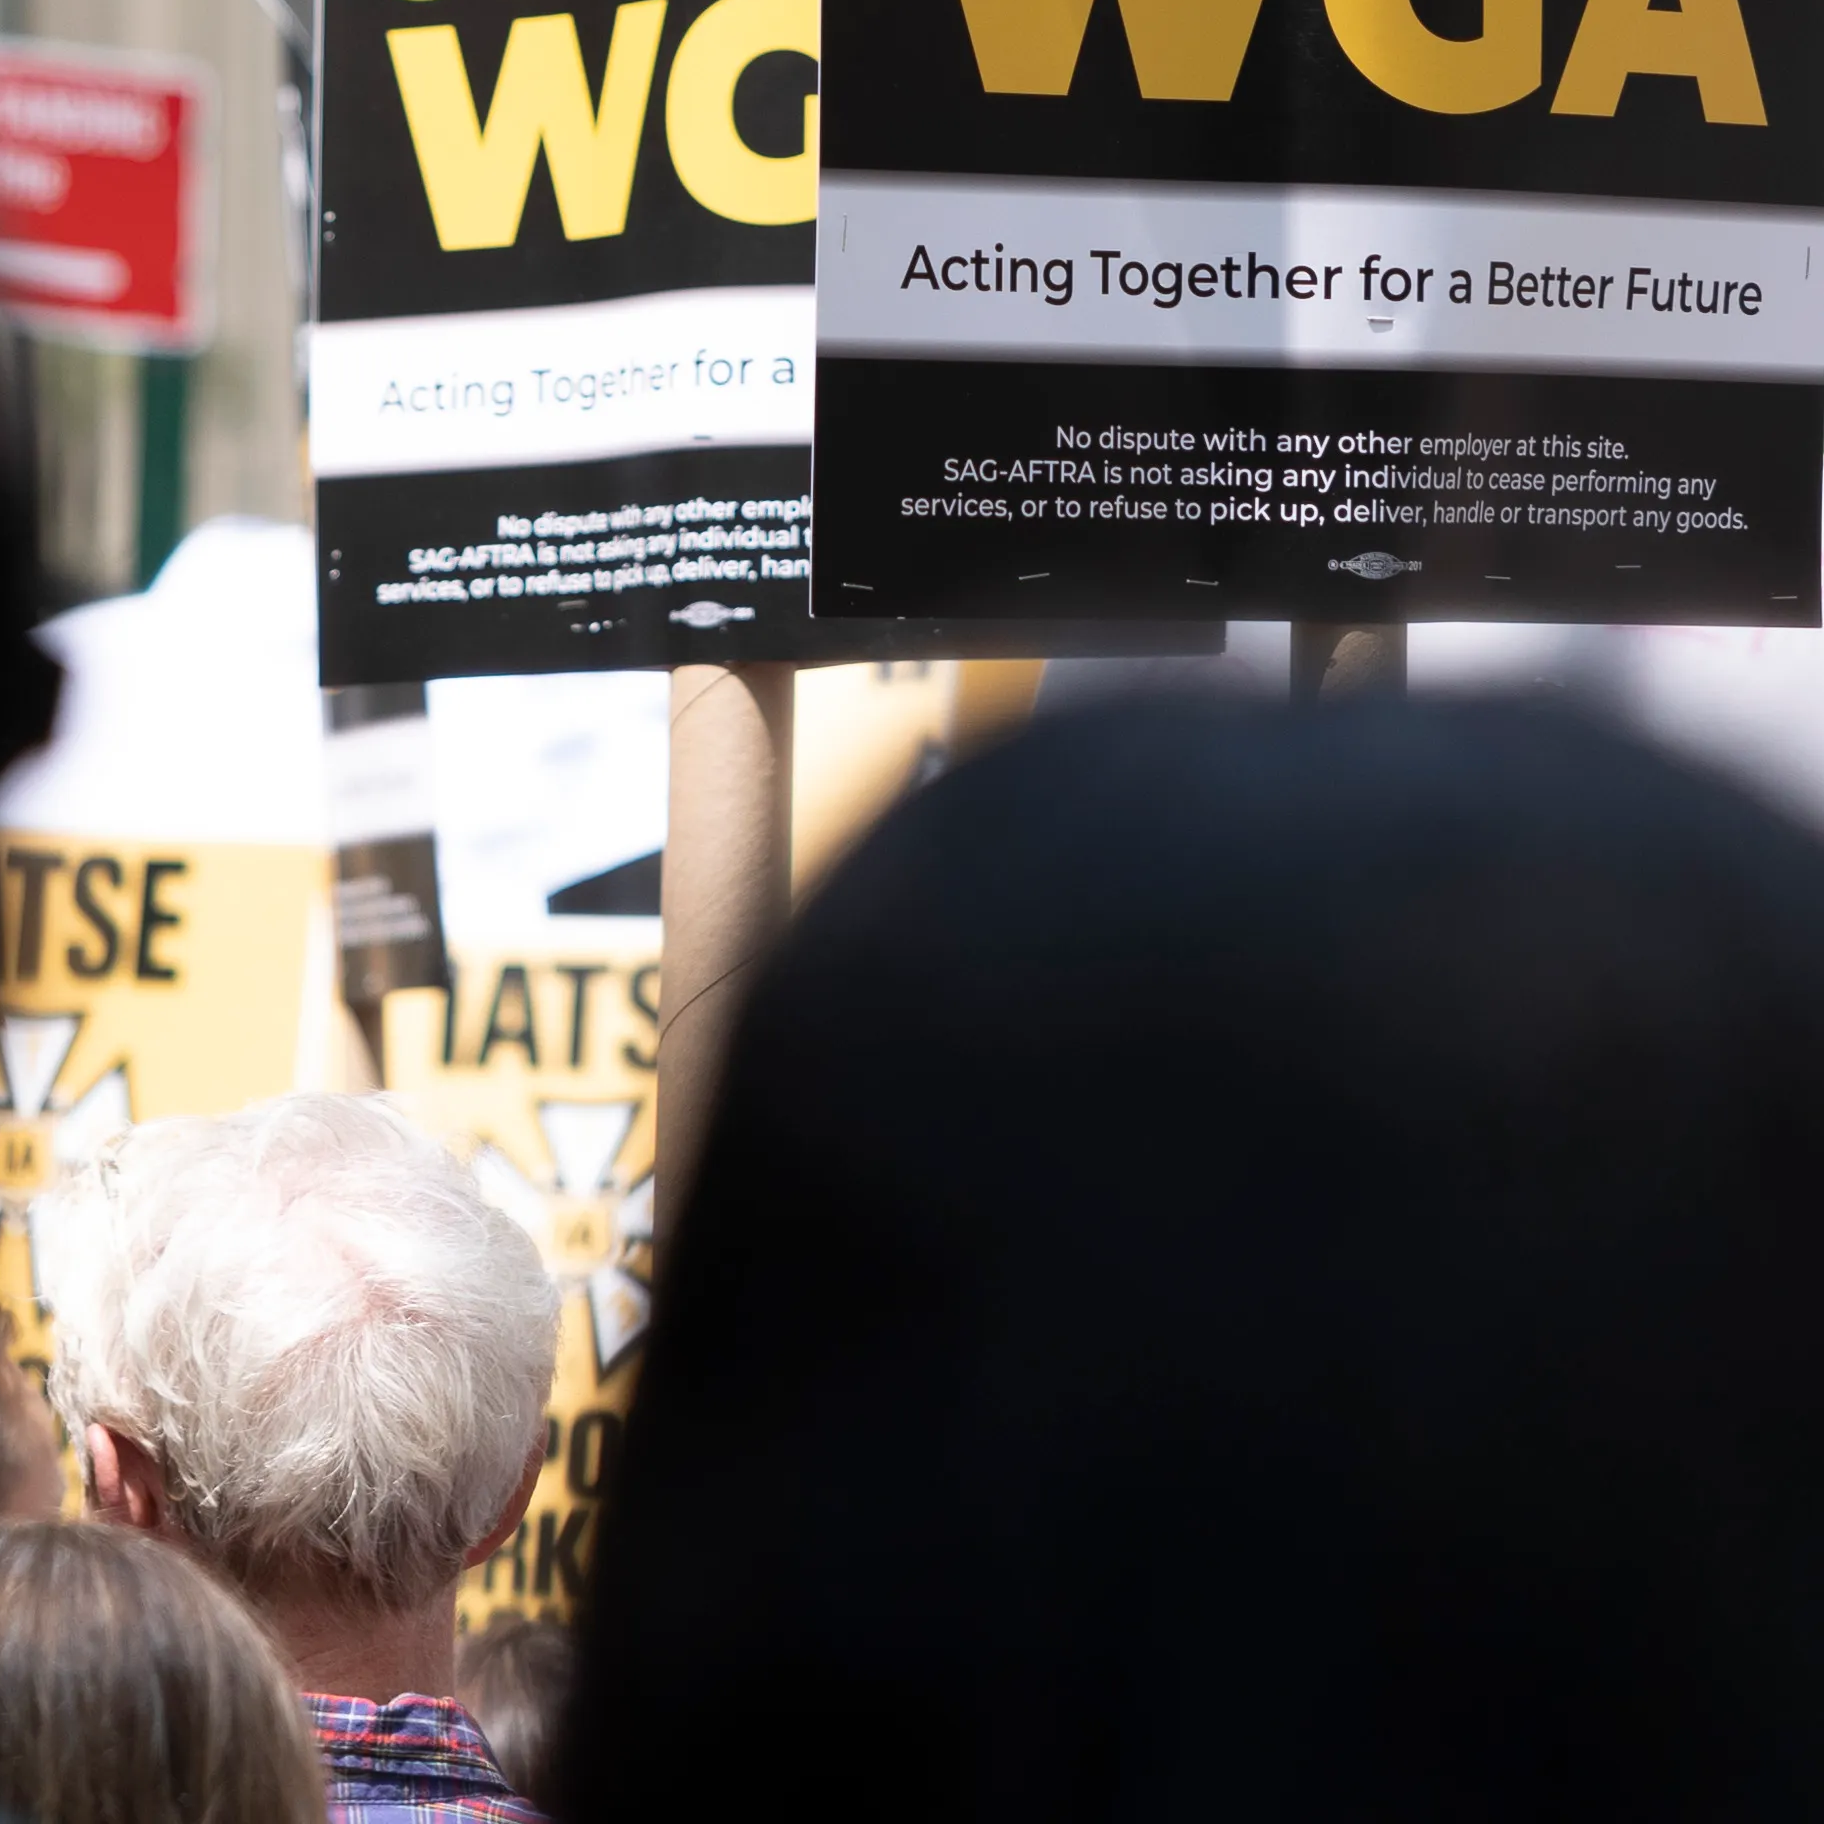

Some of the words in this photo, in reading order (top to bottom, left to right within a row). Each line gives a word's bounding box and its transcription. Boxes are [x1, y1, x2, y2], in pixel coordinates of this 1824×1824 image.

[900, 242, 1073, 306] Acting
[1089, 249, 1342, 309] Together
[1360, 254, 1434, 304] for
[1448, 269, 1472, 304] a
[1488, 260, 1614, 309] Better
[1626, 266, 1763, 316] Future
[379, 376, 515, 417] Acting
[530, 359, 678, 412] Together
[693, 348, 753, 386] for
[771, 355, 796, 386] a
[1056, 426, 1091, 450] No
[1098, 425, 1196, 455] dispute
[1203, 428, 1267, 452] with
[1276, 432, 1330, 459] any
[1337, 431, 1413, 456] other
[1419, 433, 1512, 461] employer
[1516, 437, 1536, 457] at
[1542, 435, 1582, 458] this
[1587, 436, 1629, 460] site.
[943, 458, 1095, 484] SAG-AFTRA
[1103, 461, 1122, 484] is
[1130, 464, 1172, 486] not
[1180, 462, 1272, 492] asking
[1282, 467, 1336, 493] any
[1344, 464, 1461, 490] individual
[1466, 470, 1484, 490] to
[1488, 471, 1545, 491] cease
[1551, 469, 1671, 500] performing
[1677, 475, 1716, 501] any
[497, 514, 532, 539] No
[643, 504, 674, 529] any
[675, 497, 739, 522] other
[900, 492, 1013, 521] services,
[1021, 498, 1048, 518] or
[1055, 497, 1081, 518] to
[1089, 495, 1168, 519] refuse
[1175, 499, 1201, 520] to
[1210, 497, 1270, 525] pick
[1280, 503, 1325, 527] up,
[1334, 498, 1427, 526] deliver,
[1433, 500, 1496, 525] handle
[1500, 504, 1523, 525] or
[1527, 502, 1627, 531] transport
[1633, 507, 1672, 533] any
[1677, 506, 1749, 533] goods.
[408, 543, 536, 574] SAG-AFTRA
[537, 540, 558, 567] is
[560, 540, 595, 564] not
[679, 524, 800, 551] individual
[497, 574, 524, 597] to
[672, 555, 758, 583] deliver,
